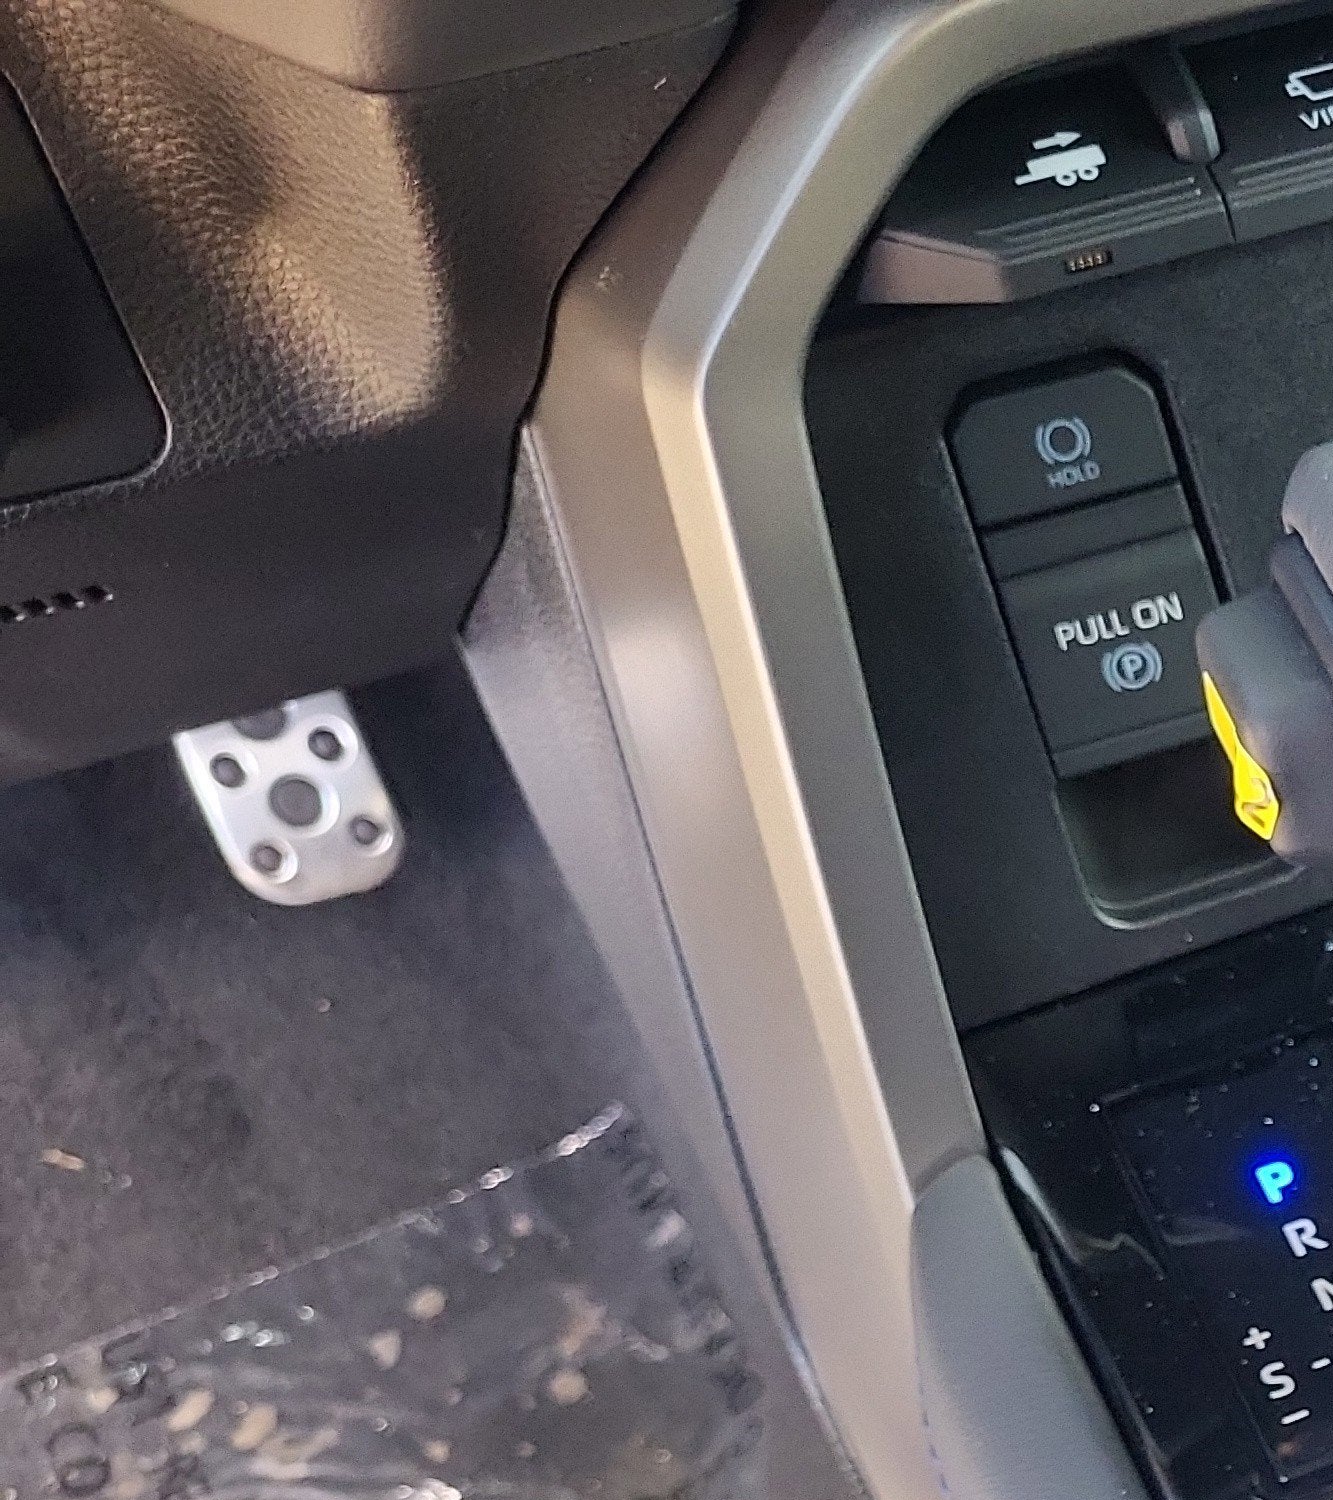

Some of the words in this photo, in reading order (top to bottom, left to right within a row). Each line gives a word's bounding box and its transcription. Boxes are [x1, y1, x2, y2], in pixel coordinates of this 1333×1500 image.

[1048, 460, 1100, 488] HOLD
[1053, 608, 1130, 651] PULL
[1131, 591, 1184, 629] ON
[1255, 1161, 1294, 1204] P
[1281, 1217, 1330, 1258] R
[1259, 1361, 1296, 1400] S
